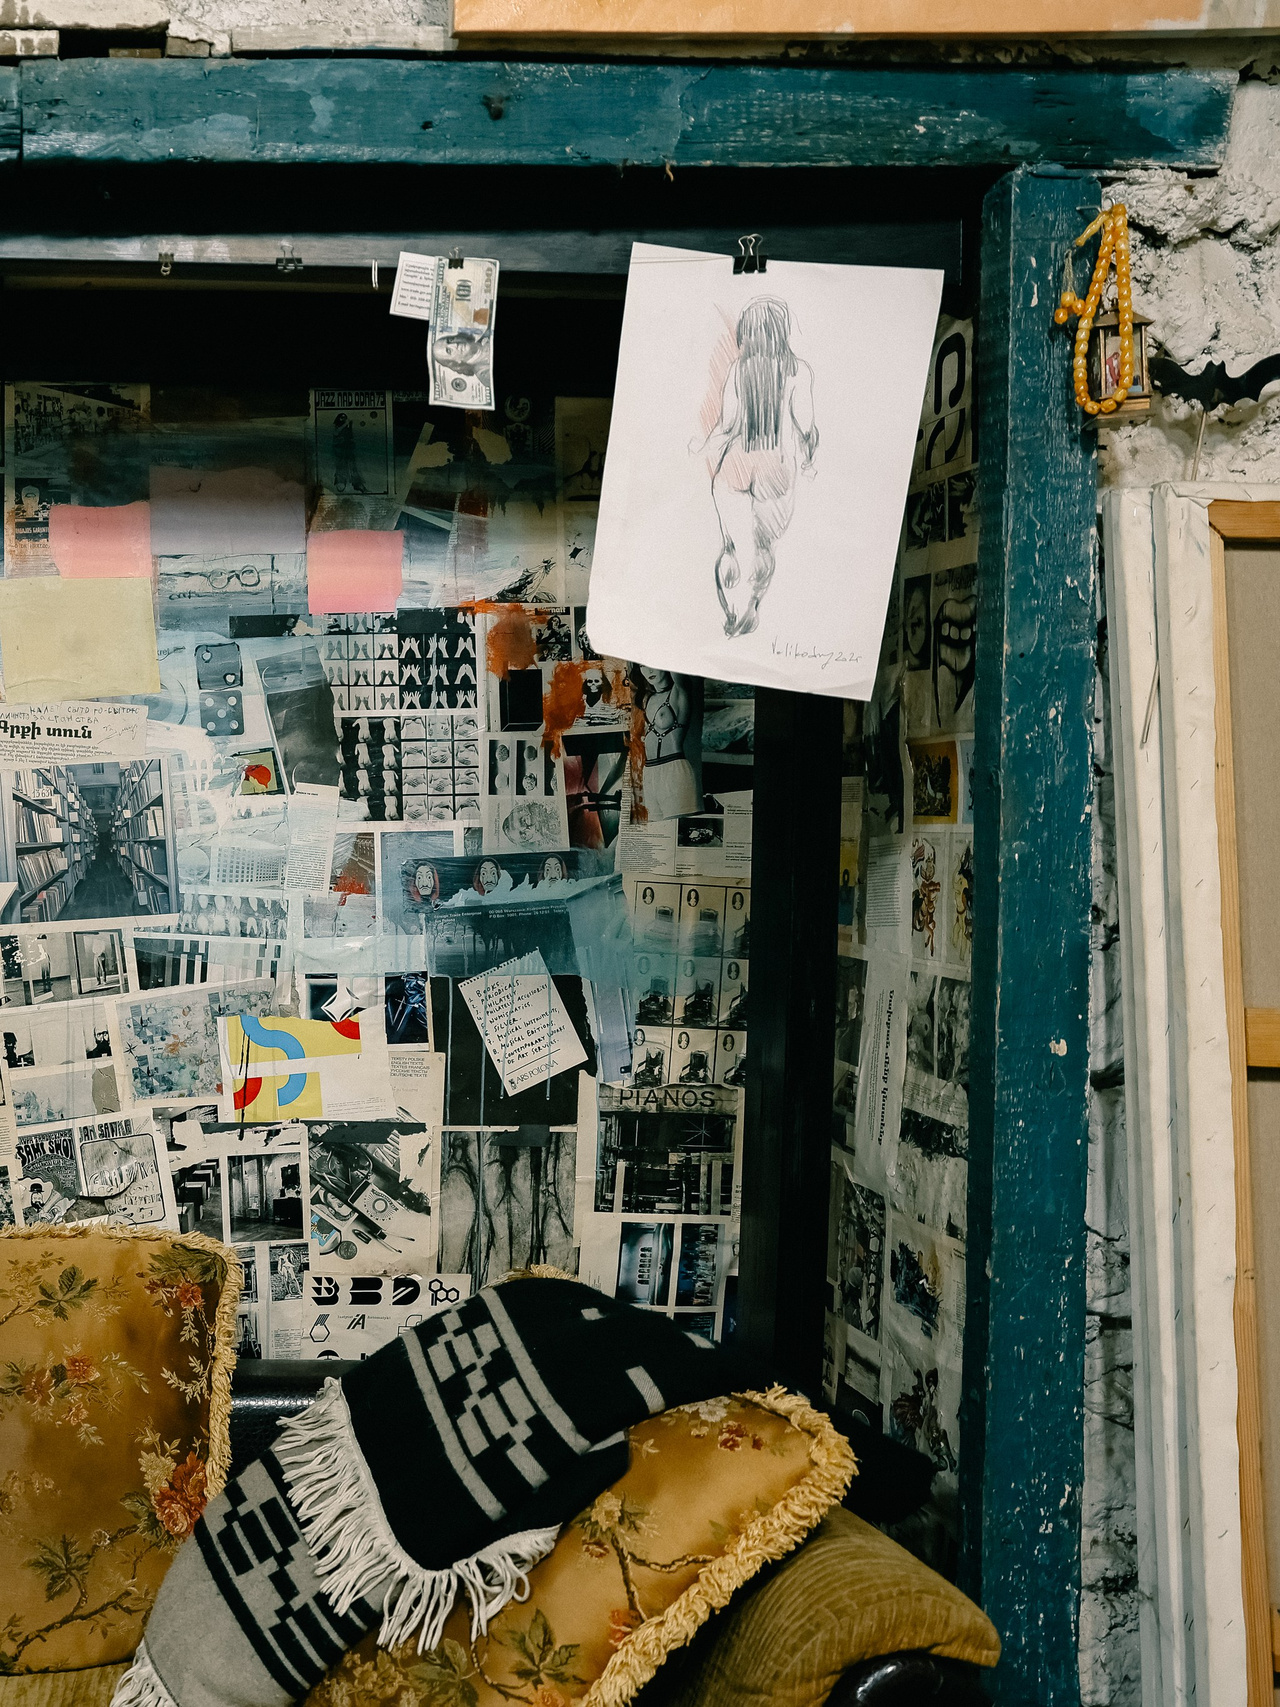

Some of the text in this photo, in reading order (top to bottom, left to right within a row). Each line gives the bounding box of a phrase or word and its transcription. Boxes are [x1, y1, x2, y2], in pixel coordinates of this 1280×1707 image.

[46, 724, 93, 740] տուն
[515, 1073, 529, 1085] ARS
[618, 1088, 715, 1108] PIANOS
